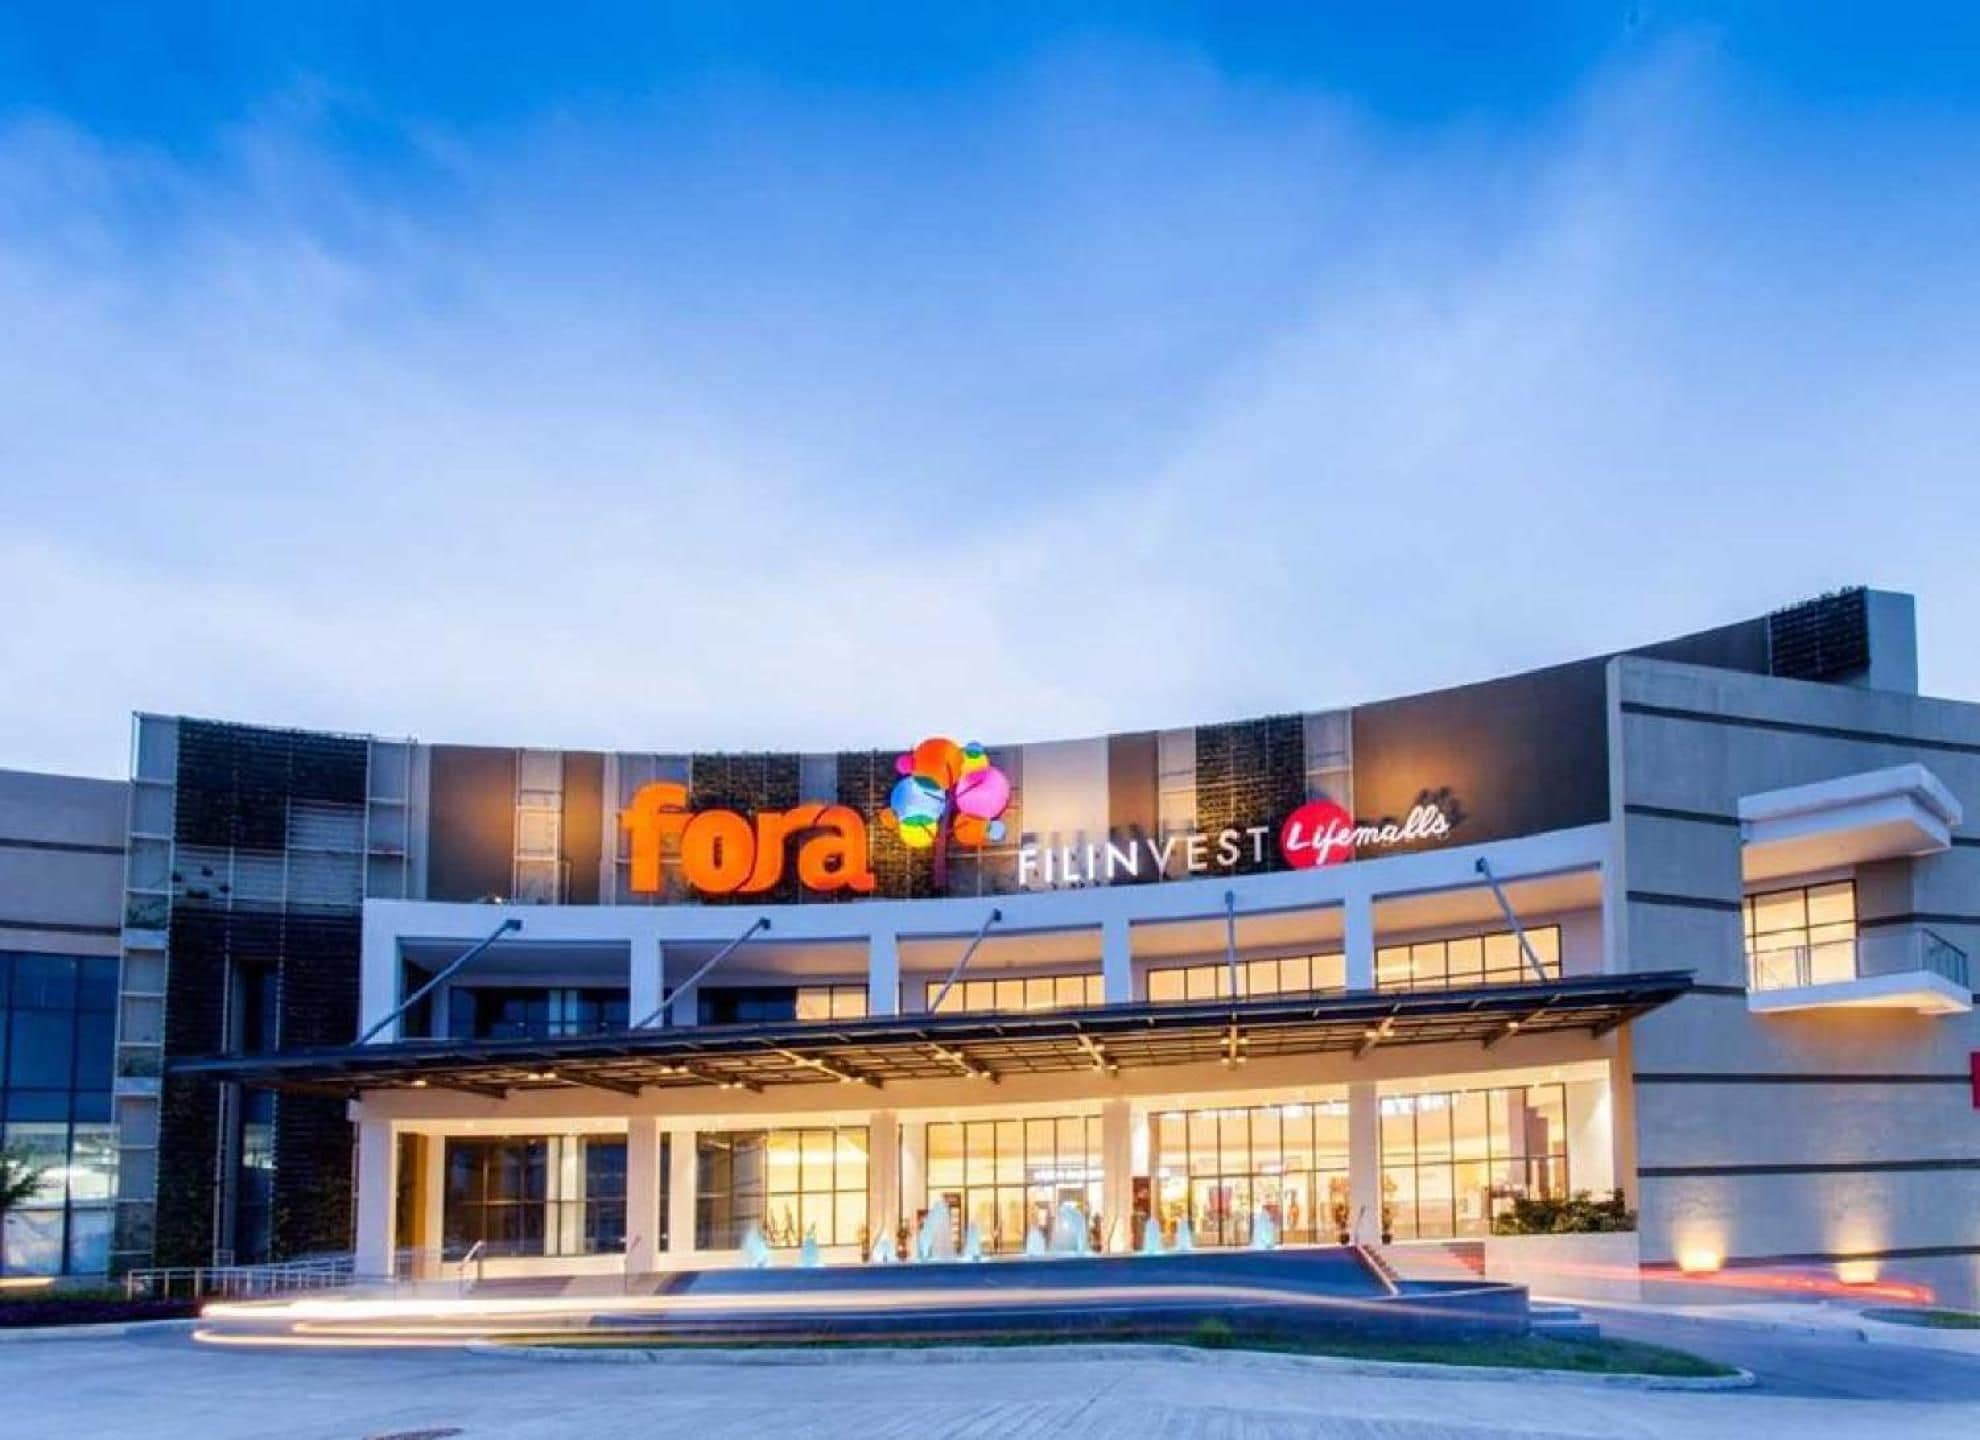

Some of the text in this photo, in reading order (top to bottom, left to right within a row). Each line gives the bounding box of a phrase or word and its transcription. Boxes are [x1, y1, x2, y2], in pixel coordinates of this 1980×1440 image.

[619, 780, 875, 894] fora
[1018, 804, 1449, 887] FILINVEST Lifemalls
